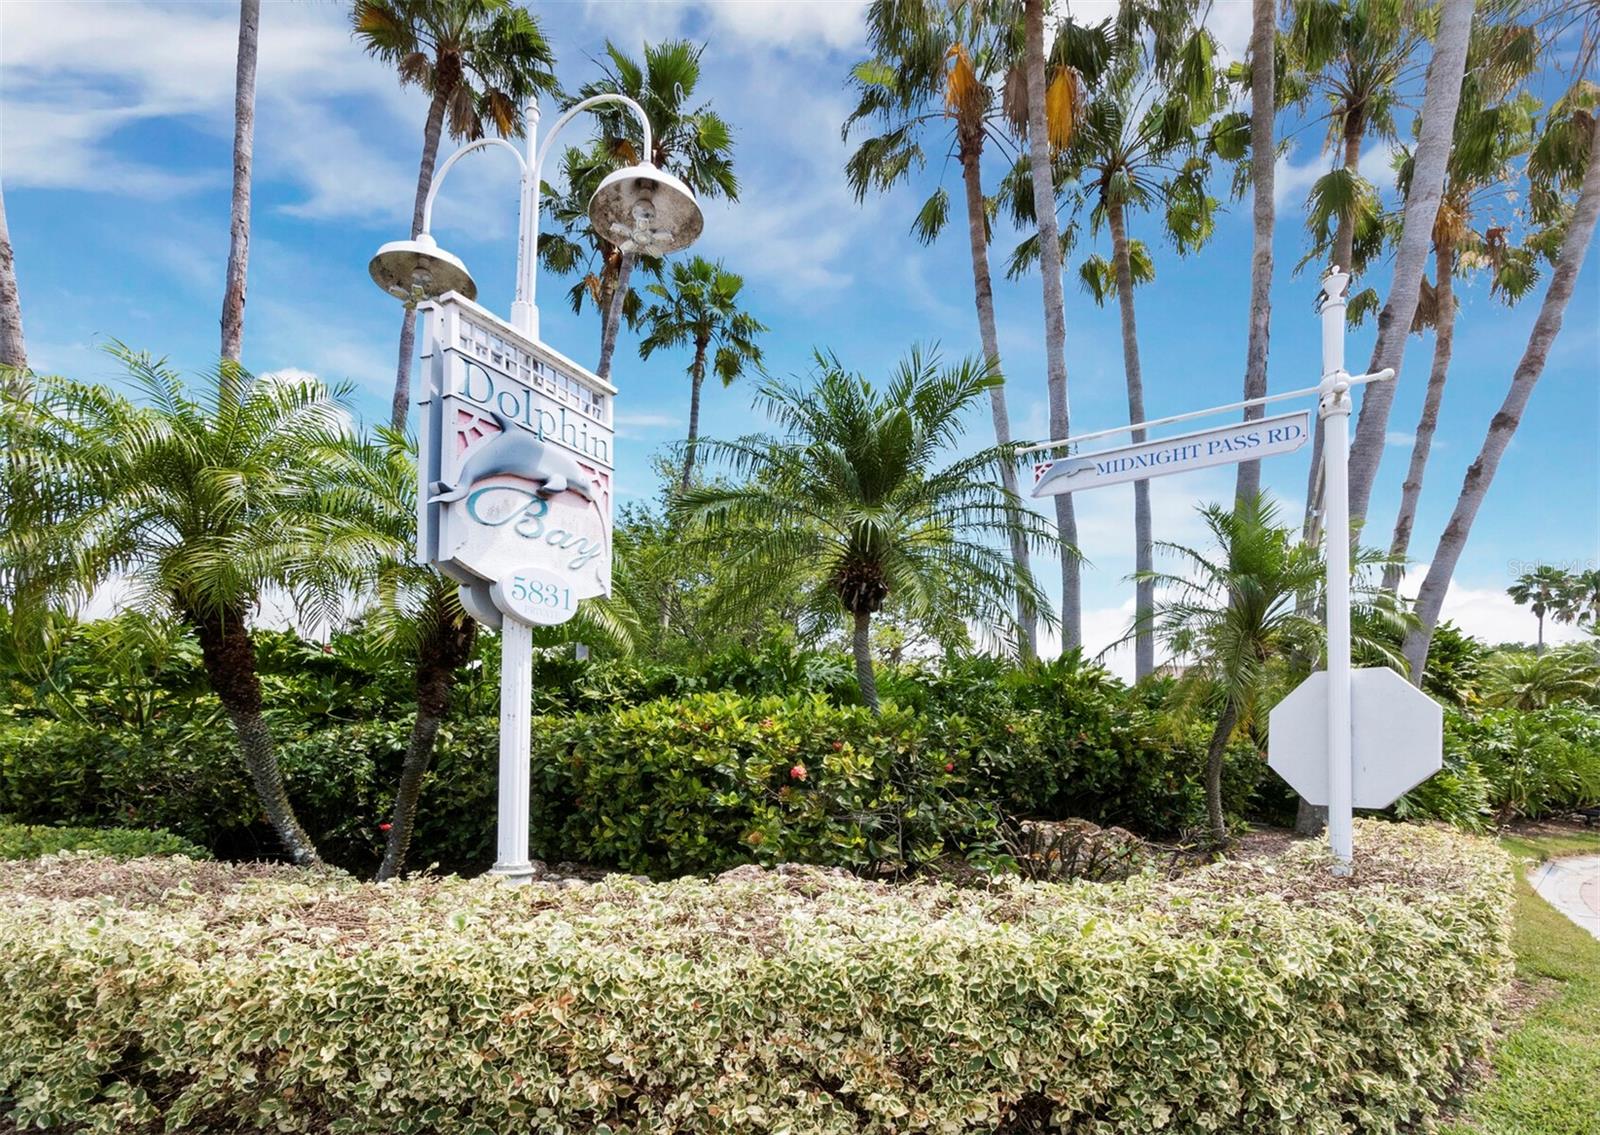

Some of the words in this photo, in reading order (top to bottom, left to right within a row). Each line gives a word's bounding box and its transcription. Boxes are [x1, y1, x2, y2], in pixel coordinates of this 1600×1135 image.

[458, 356, 609, 462] Dolphin
[1096, 443, 1202, 476] MIDNIGHT
[1208, 431, 1261, 455] PASS
[1268, 424, 1306, 444] RD.
[466, 486, 602, 570] Bay
[511, 576, 571, 611] 5831
